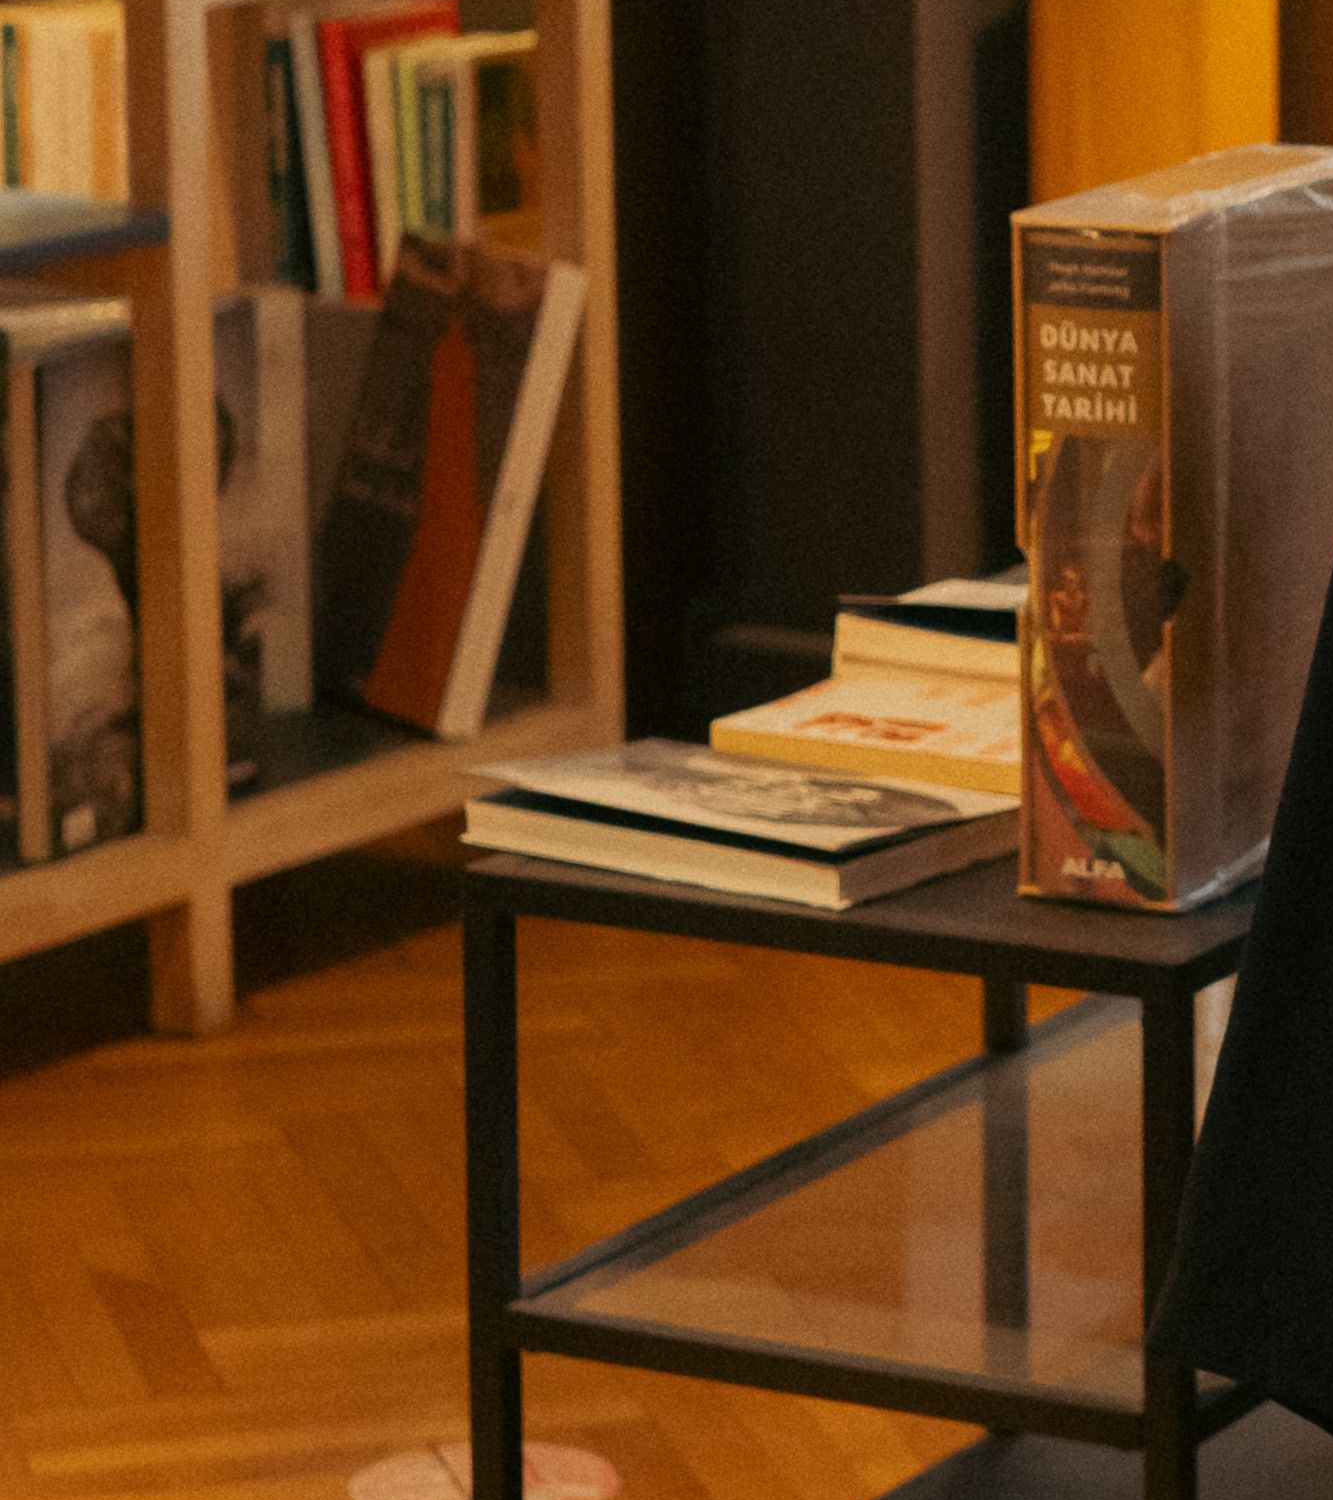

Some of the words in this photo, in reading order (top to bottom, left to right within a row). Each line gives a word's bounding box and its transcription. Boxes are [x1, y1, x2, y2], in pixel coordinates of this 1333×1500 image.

[1039, 320, 1138, 355] DÜNYA
[1042, 358, 1134, 388] SANAT
[1041, 392, 1138, 424] TARİHİ
[1062, 857, 1126, 881] ALFA
